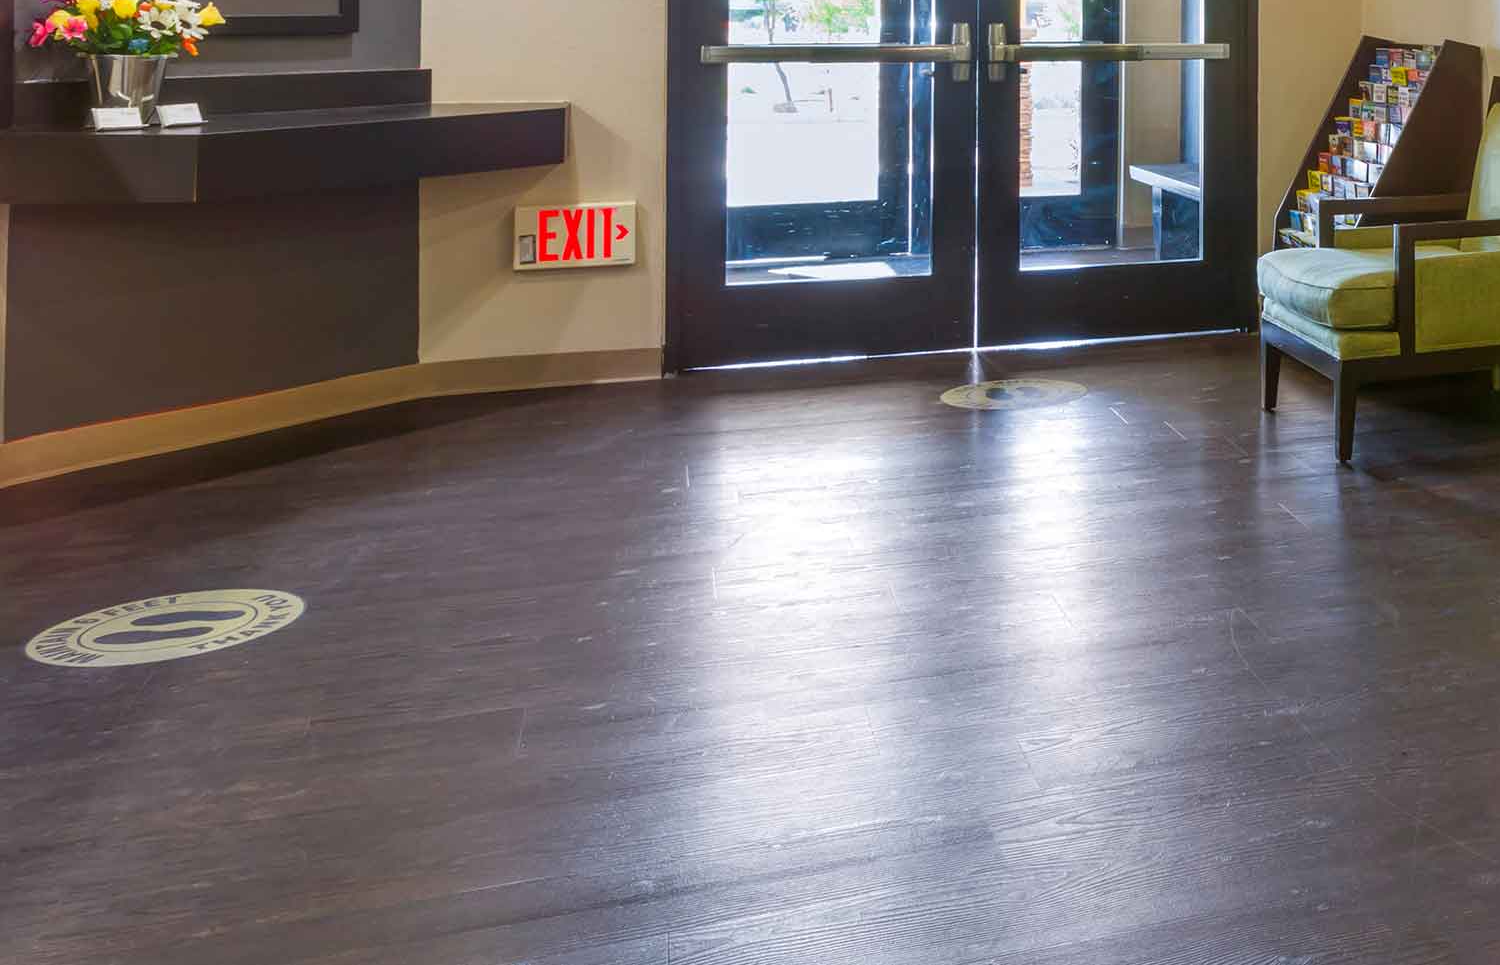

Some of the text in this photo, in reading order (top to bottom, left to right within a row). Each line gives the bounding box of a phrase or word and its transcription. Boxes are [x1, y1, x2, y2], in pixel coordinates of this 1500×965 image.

[538, 207, 615, 262] EXIT
[35, 627, 104, 664] MAINTAIN
[101, 595, 180, 616] FEET
[189, 594, 293, 650] THANK YOU
